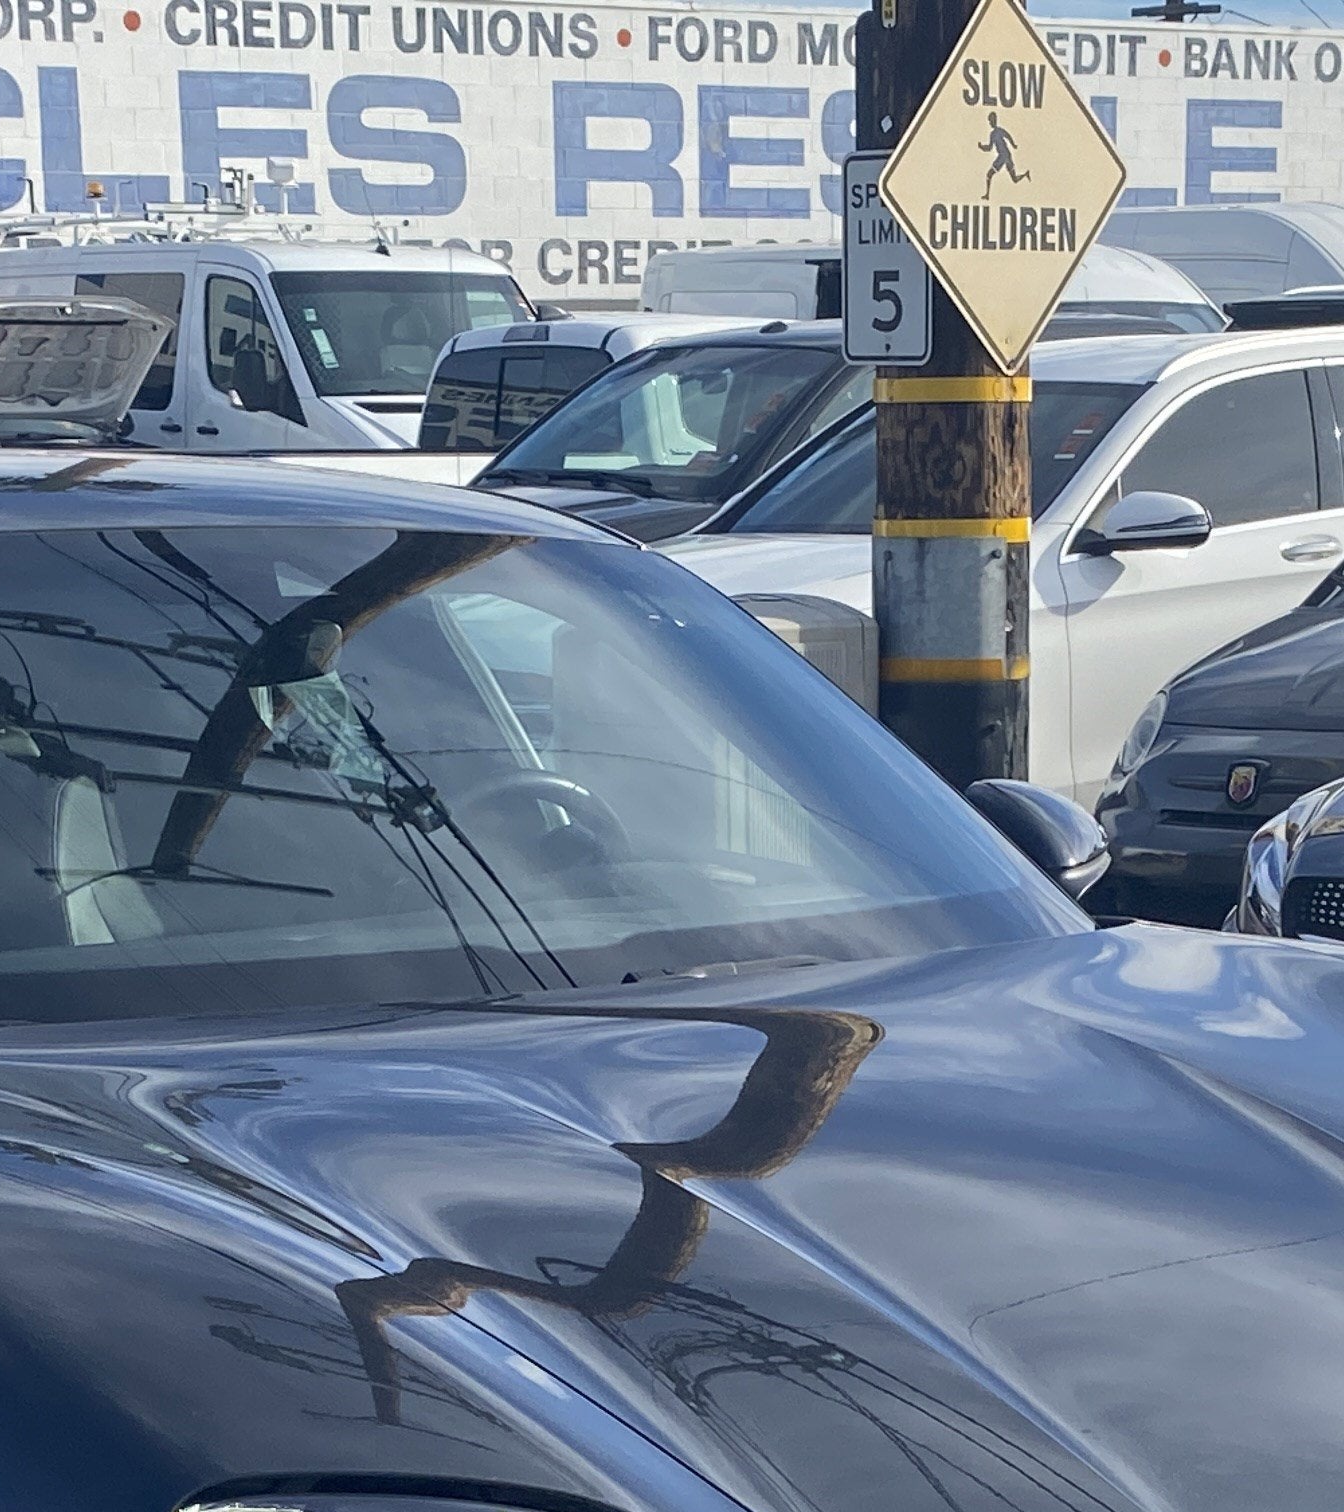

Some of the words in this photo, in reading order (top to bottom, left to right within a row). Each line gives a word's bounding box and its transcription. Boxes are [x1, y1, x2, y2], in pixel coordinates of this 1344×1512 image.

[164, 0, 372, 51] CREDIT
[392, 7, 599, 60] UNIONS
[648, 16, 779, 63] FORD
[1046, 31, 1147, 78] EDIT
[961, 57, 1047, 110] SLOW
[1185, 37, 1298, 81] BANK
[929, 202, 1077, 253] CHILDREN
[872, 270, 904, 333] 5
